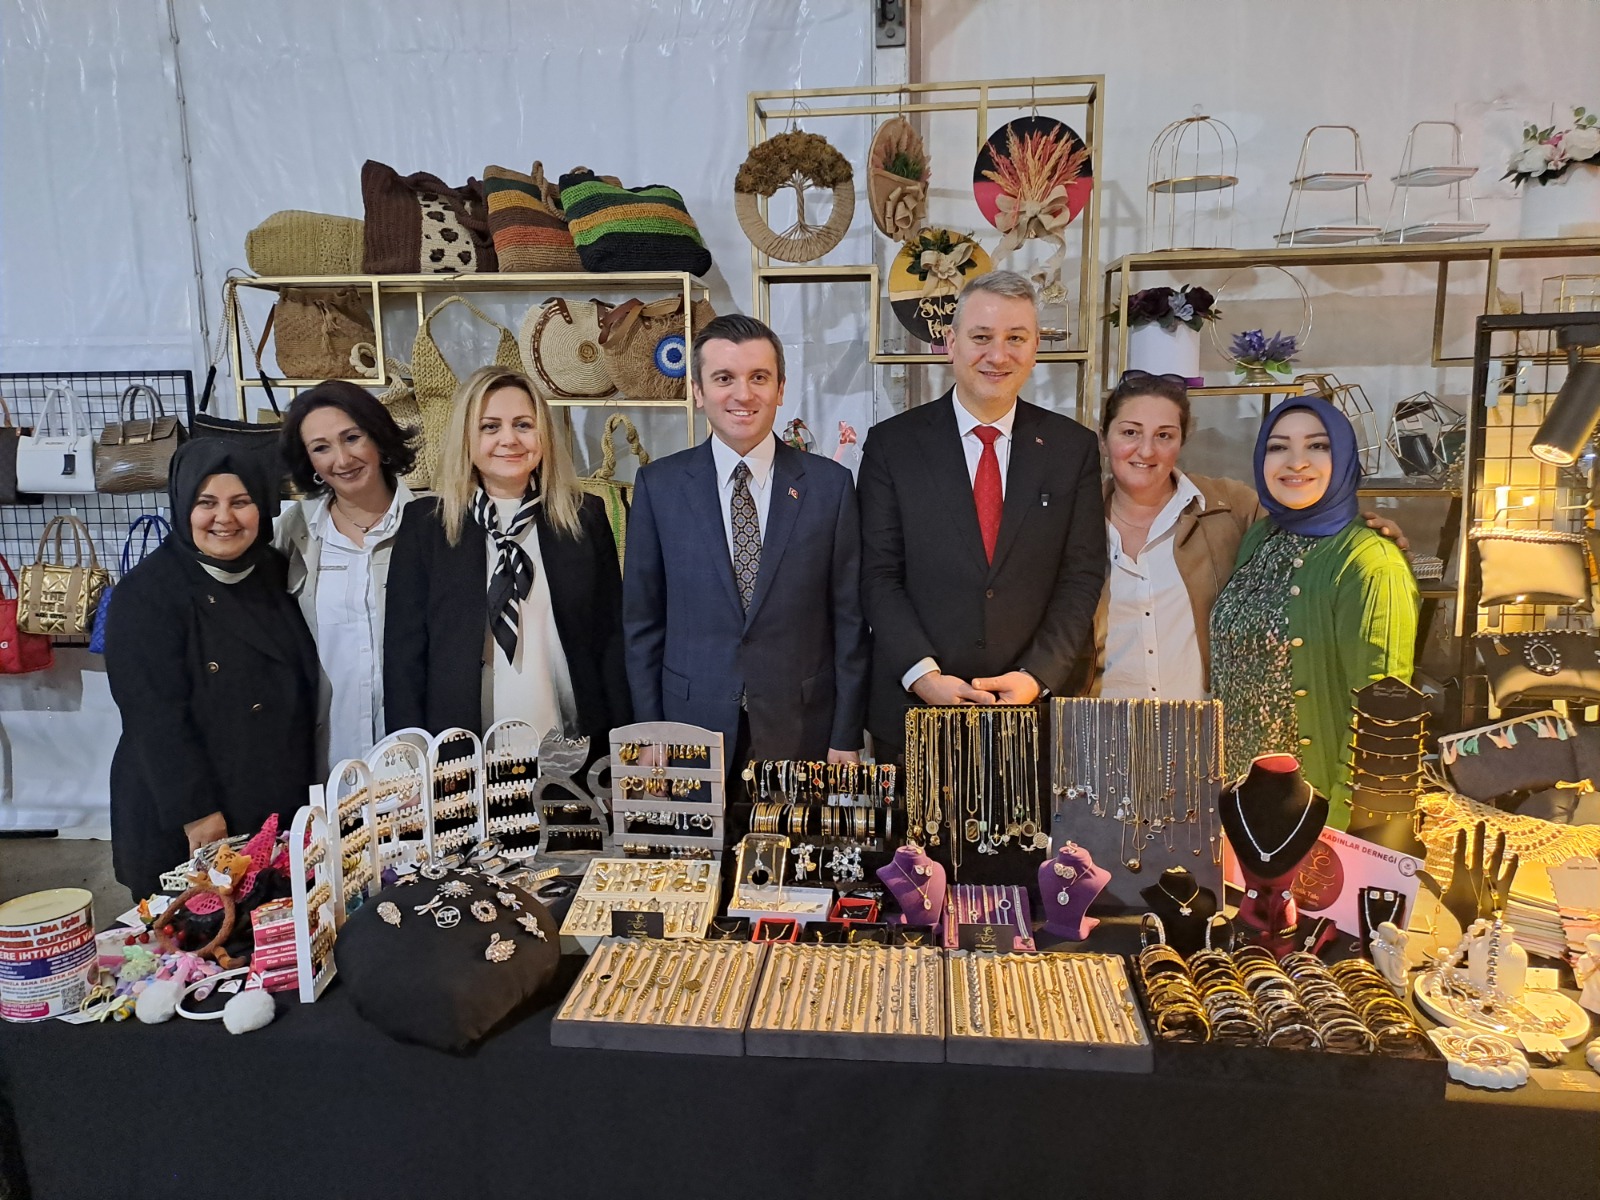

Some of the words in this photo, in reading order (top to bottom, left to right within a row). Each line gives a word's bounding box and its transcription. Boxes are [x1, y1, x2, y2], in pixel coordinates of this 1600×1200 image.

[919, 298, 956, 318] Swe
[1321, 832, 1361, 850] KADINLAR
[1361, 845, 1398, 864] DERNEĞİ
[0, 951, 16, 960] ERE
